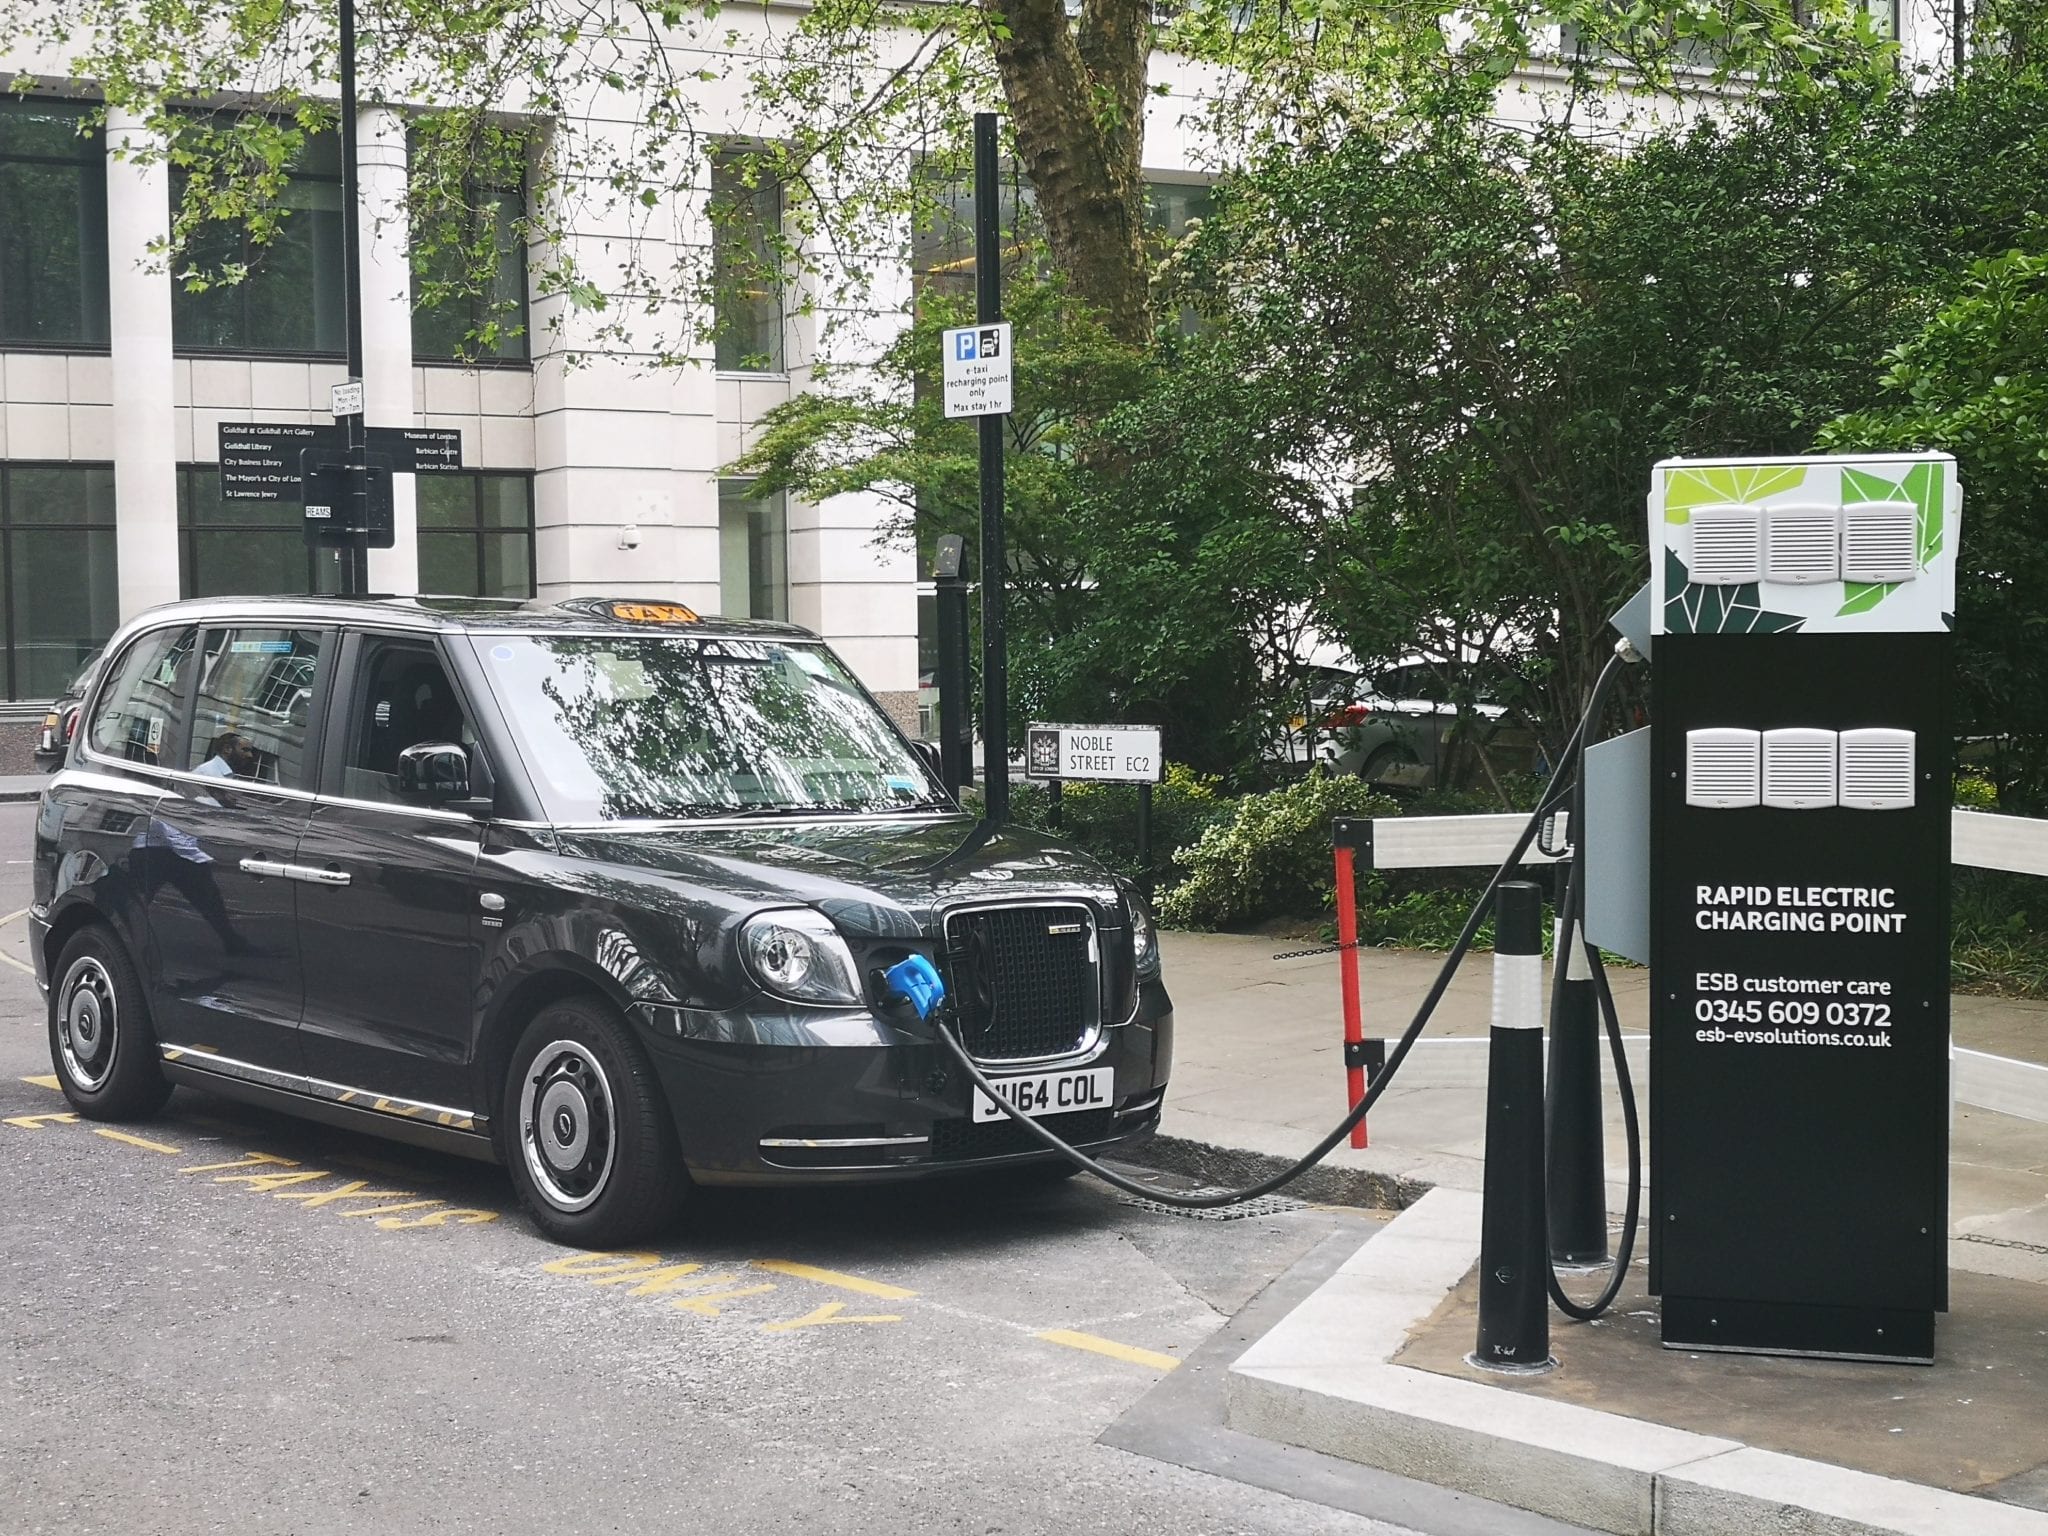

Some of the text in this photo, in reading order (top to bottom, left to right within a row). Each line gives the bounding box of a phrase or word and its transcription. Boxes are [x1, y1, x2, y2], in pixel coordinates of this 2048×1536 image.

[947, 374, 1008, 387] recharging point
[970, 388, 985, 397] only
[954, 403, 968, 412] Max
[972, 402, 987, 411] stay
[224, 458, 237, 466] City
[263, 459, 282, 467] Library
[262, 491, 277, 499] Jewry
[619, 607, 692, 619] TAXI
[1070, 736, 1113, 751] NOBLE
[1070, 755, 1150, 772] STREET EC2
[1696, 886, 1895, 908] RAPID ELECTRIC
[1695, 910, 1907, 934] CHARGING POINT
[1696, 972, 1892, 996] ESB customer care
[1695, 999, 1892, 1027] 0345 609 0372
[1696, 1027, 1892, 1048] esb-evsolutions.co.uk
[1058, 1075, 1103, 1107] COL
[542, 1250, 904, 1332] ONLY
